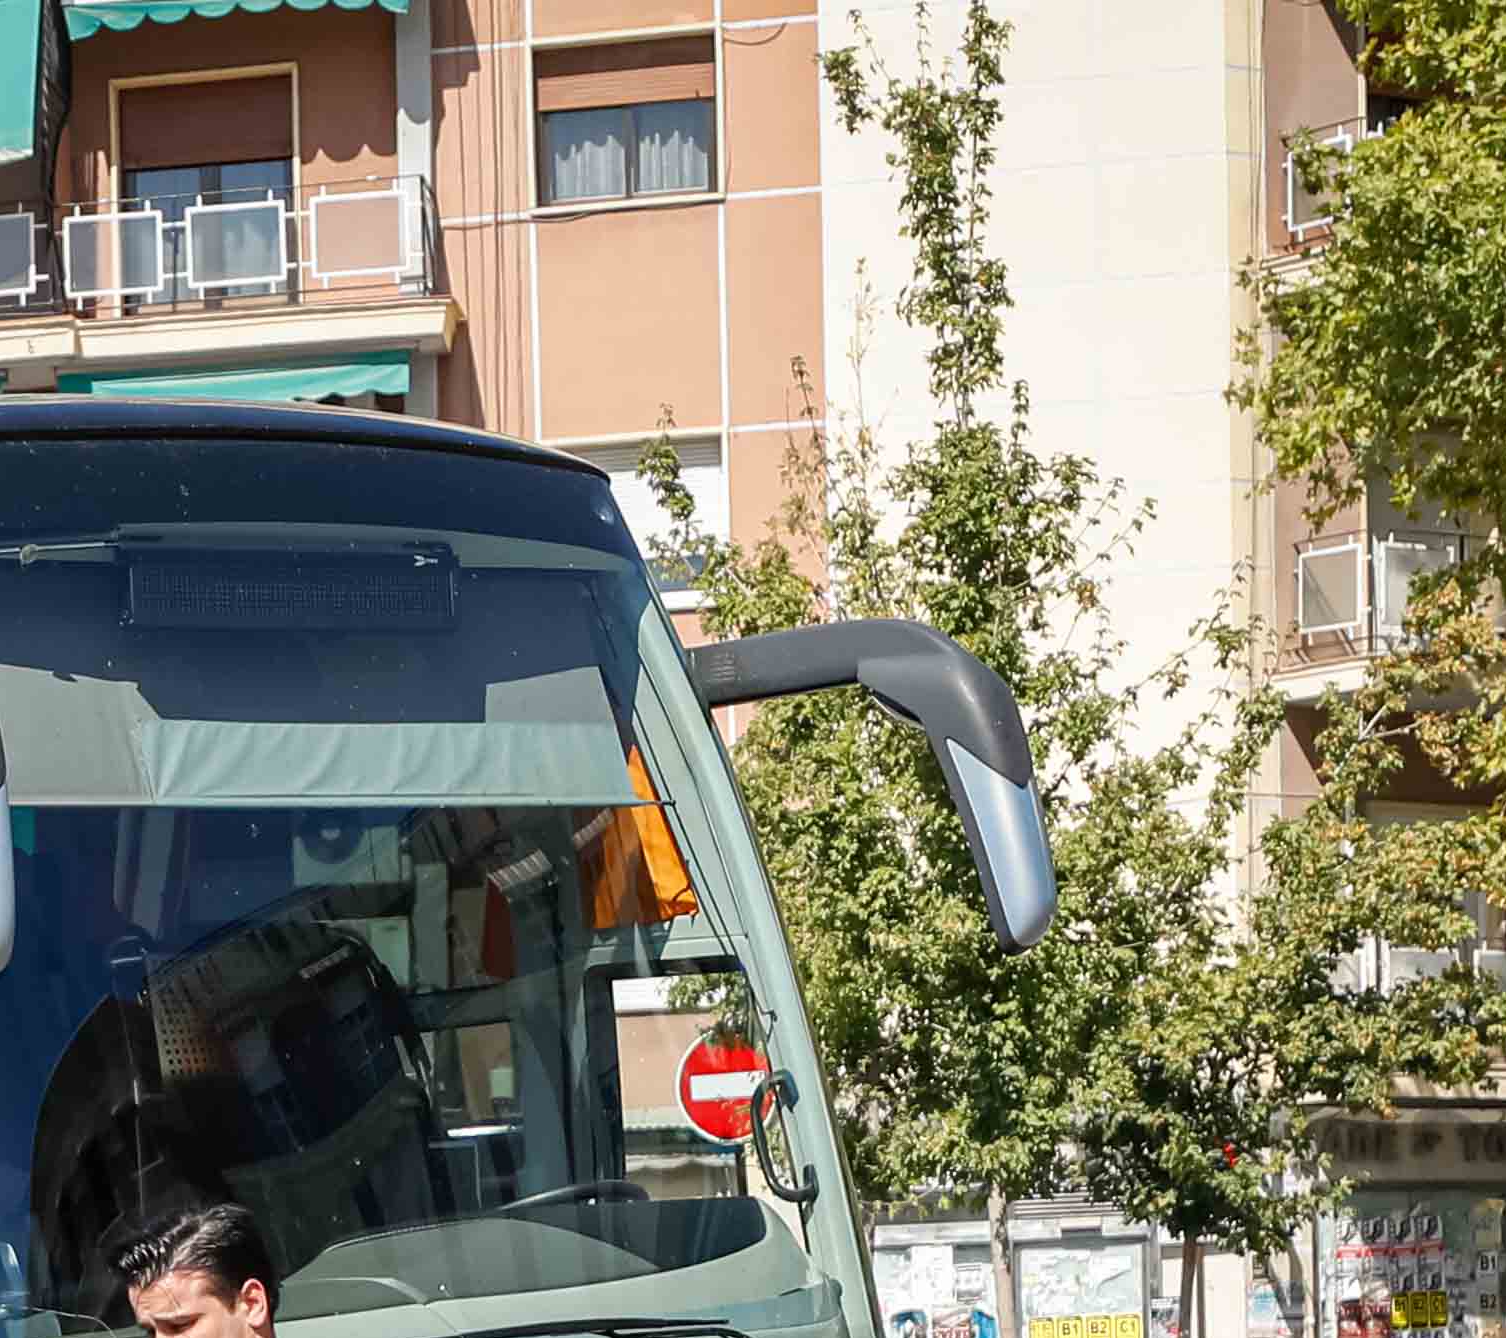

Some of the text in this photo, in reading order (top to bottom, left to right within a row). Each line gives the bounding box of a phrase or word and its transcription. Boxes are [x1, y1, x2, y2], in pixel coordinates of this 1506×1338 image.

[1062, 1320, 1136, 1336] B1 B2 C1
